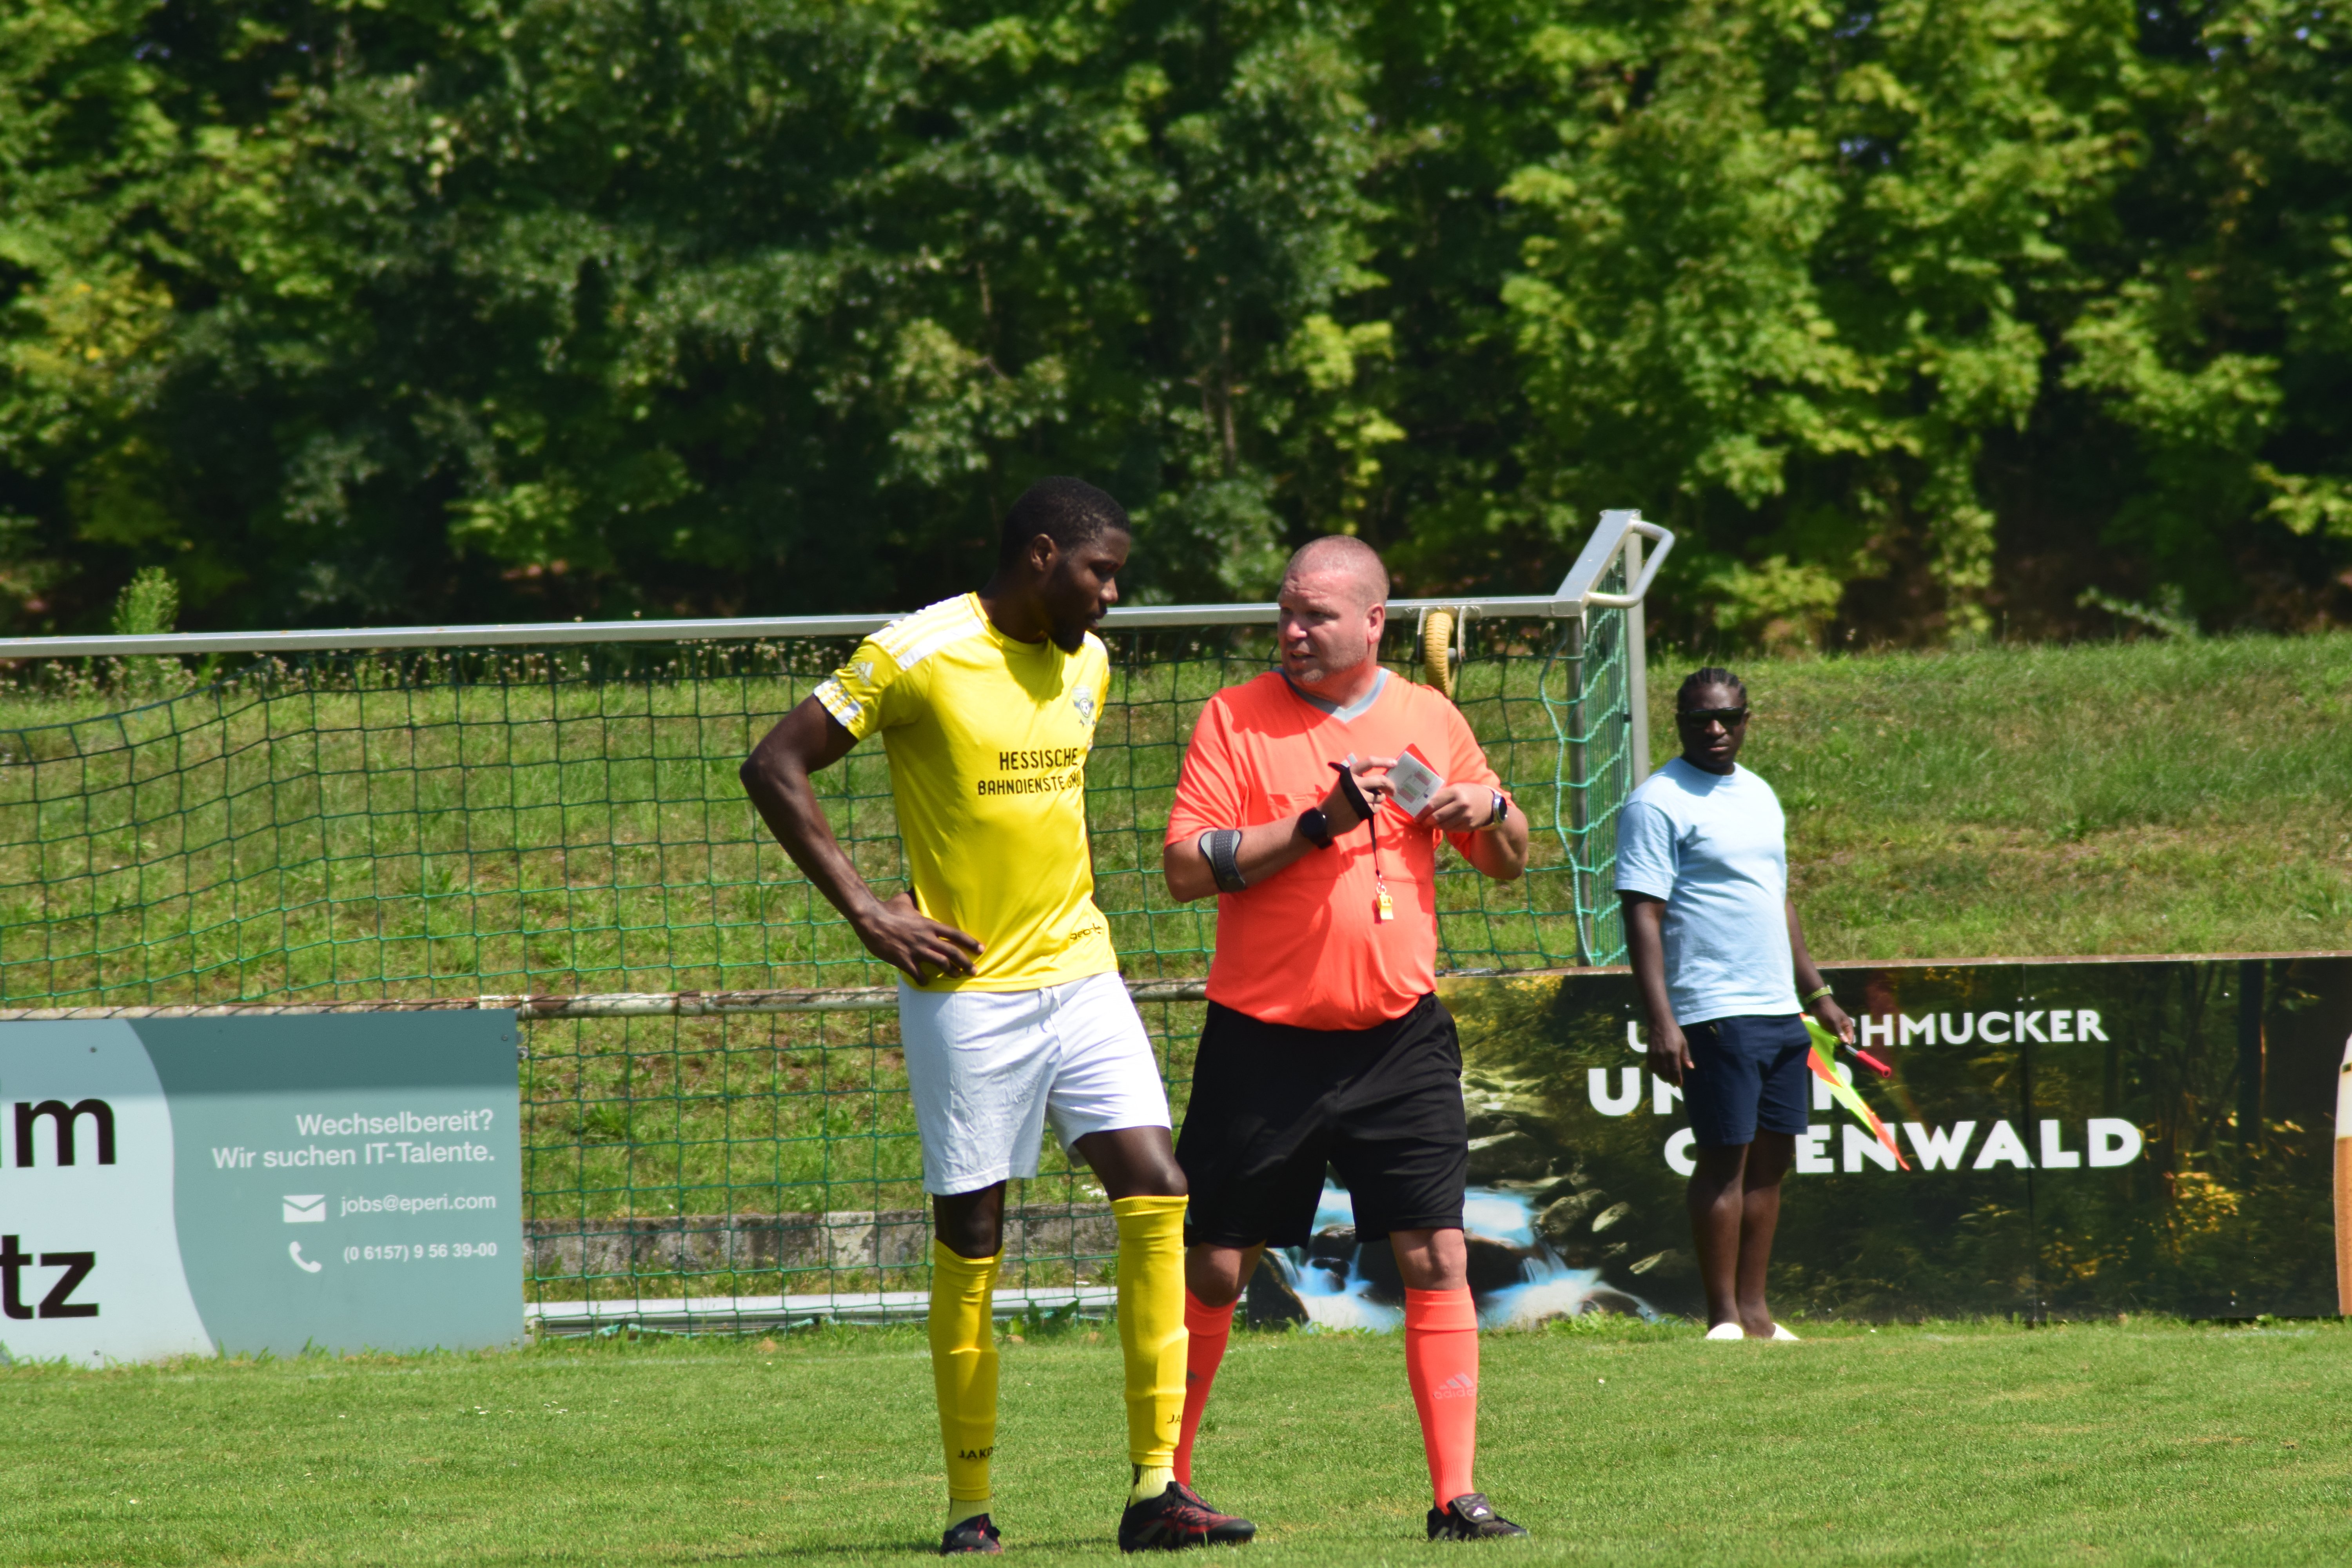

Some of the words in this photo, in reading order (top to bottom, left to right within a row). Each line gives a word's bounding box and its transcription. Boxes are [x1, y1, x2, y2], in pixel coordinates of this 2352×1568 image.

[999, 748, 1078, 771] HESSISCHE
[978, 776, 1065, 795] BAHNDIENSTE
[1802, 1010, 2109, 1047] HMUCKER
[296, 1109, 494, 1136] Wechselbereit?
[212, 1147, 256, 1169] Wir
[263, 1144, 356, 1167] suchen
[365, 1141, 495, 1164] IT-Talente.
[340, 1193, 497, 1217] jobs@eperi.com
[344, 1246, 359, 1264] (0
[364, 1245, 409, 1262] 6157)
[413, 1245, 424, 1259] 9
[428, 1244, 448, 1258] 56
[452, 1242, 497, 1258] 39-00
